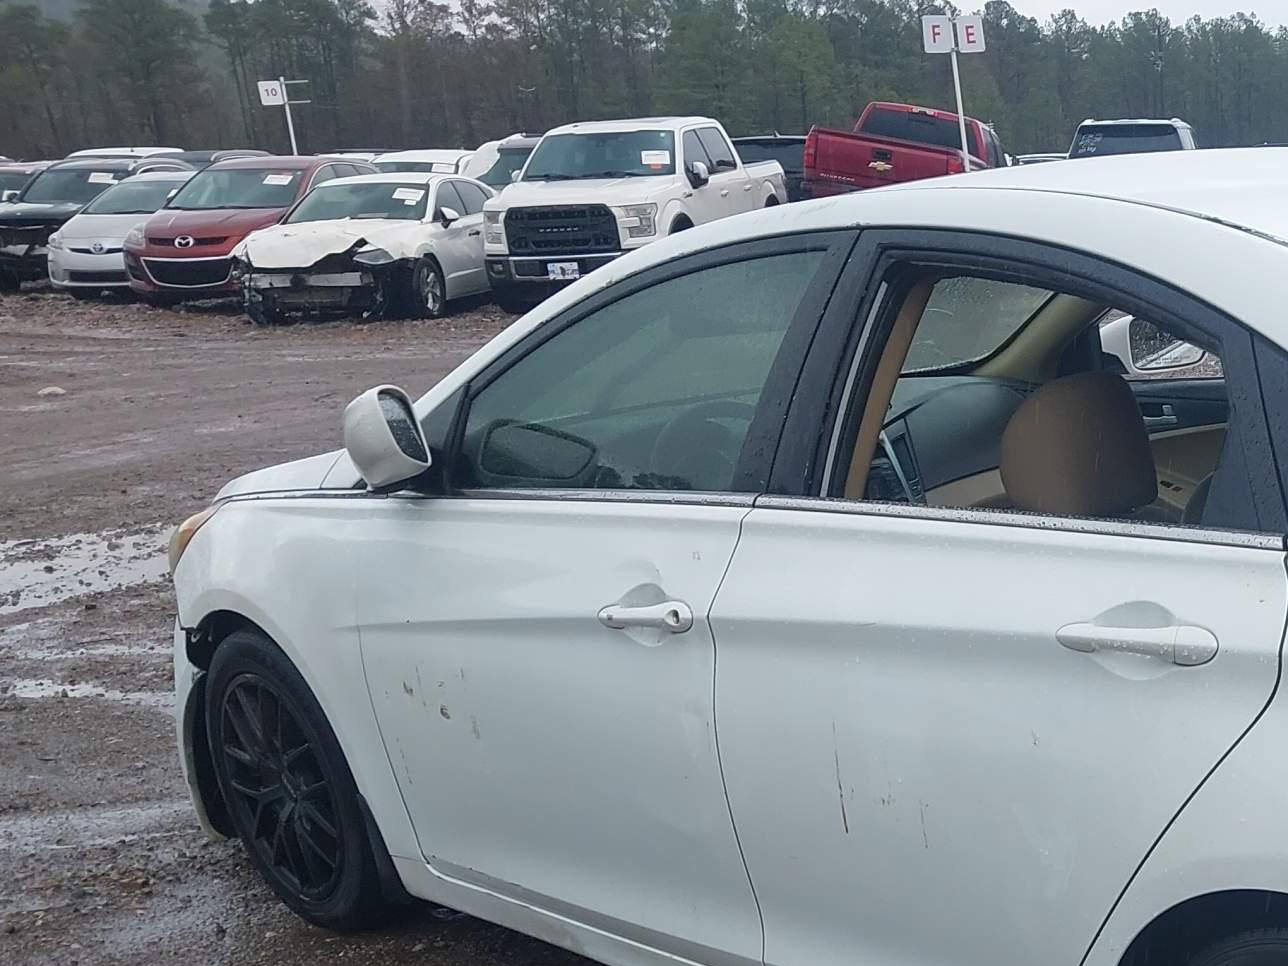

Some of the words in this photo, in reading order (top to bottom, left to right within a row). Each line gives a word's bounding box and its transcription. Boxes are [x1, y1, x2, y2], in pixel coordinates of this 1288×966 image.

[931, 24, 941, 44] F
[964, 25, 977, 44] E
[264, 88, 278, 97] 10
